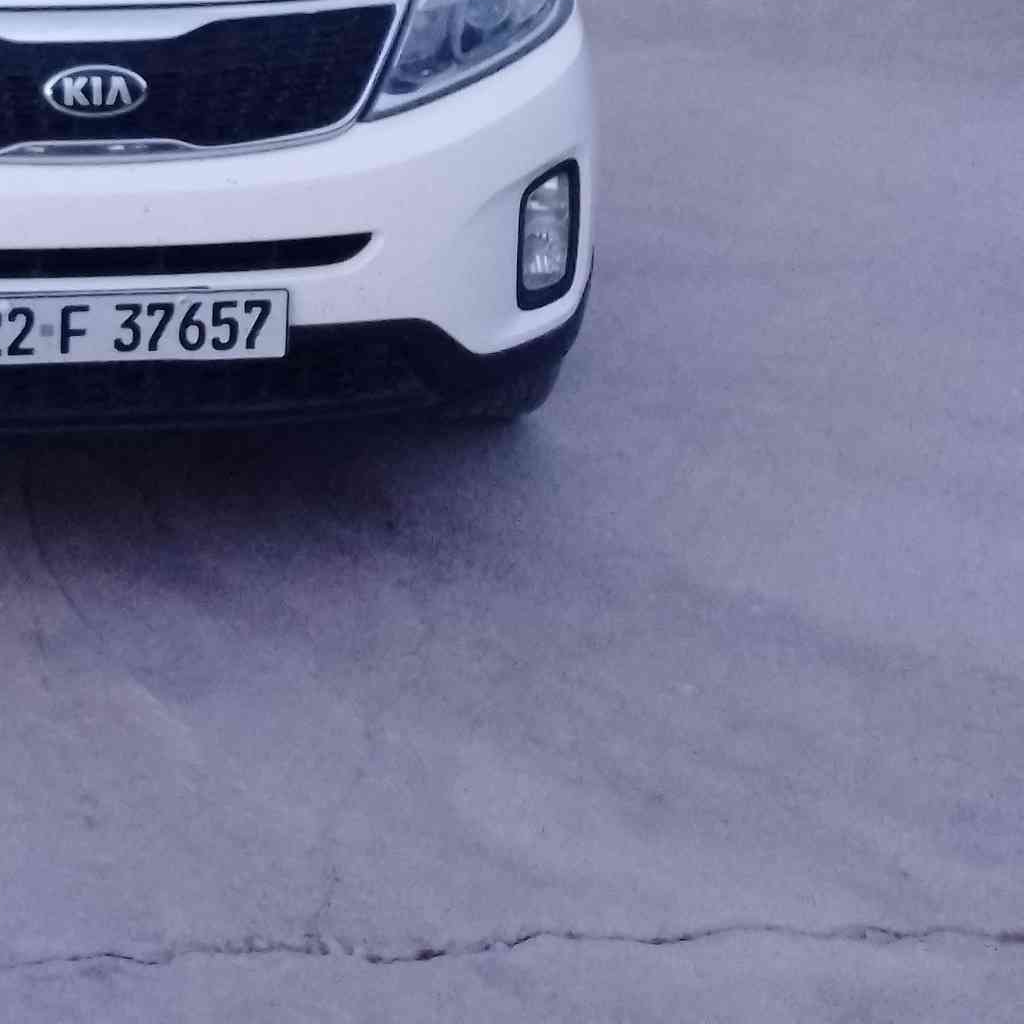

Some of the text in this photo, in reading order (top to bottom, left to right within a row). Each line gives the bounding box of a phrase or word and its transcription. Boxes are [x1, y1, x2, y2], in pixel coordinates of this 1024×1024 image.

[63, 76, 132, 106] KIA
[60, 305, 90, 354] F
[113, 299, 273, 352] 37657
